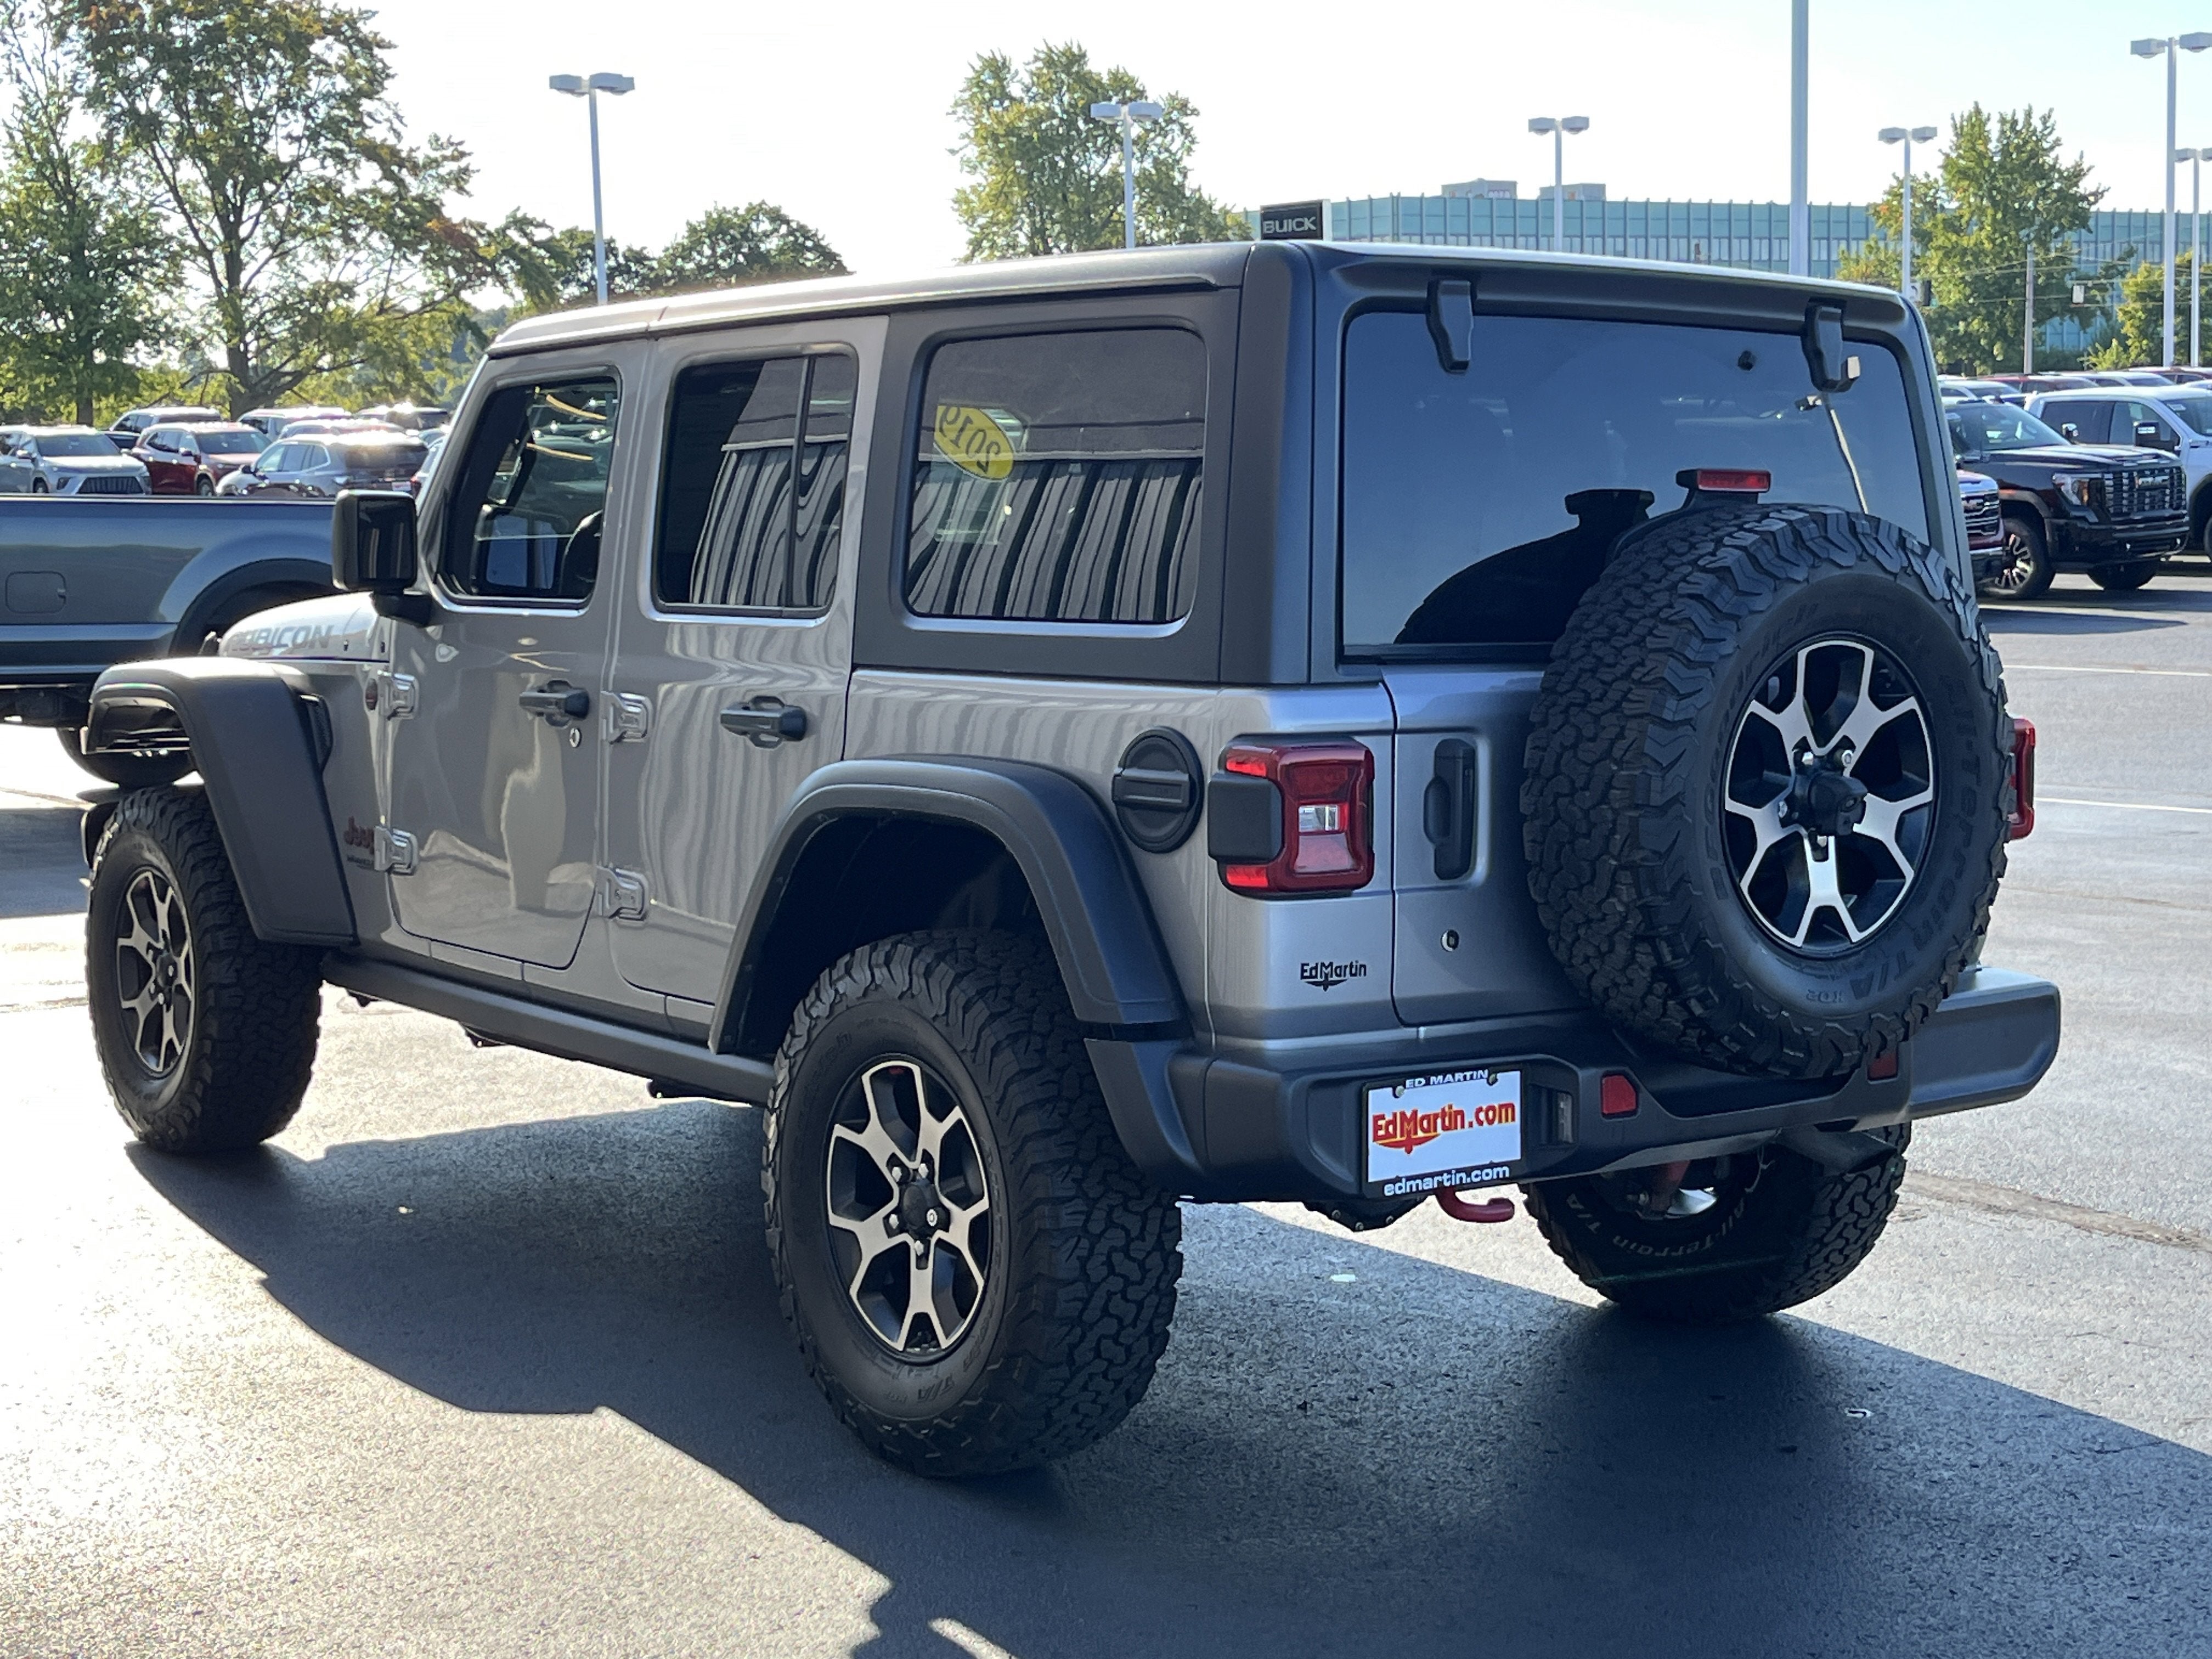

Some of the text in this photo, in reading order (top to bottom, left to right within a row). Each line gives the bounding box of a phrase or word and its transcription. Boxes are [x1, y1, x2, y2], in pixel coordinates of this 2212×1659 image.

[1262, 216, 1317, 234] BUICK
[1300, 960, 1367, 980] EdMartin
[1406, 1069, 1489, 1089] ED MARTIN
[1384, 1165, 1510, 1197] edmartin.com
